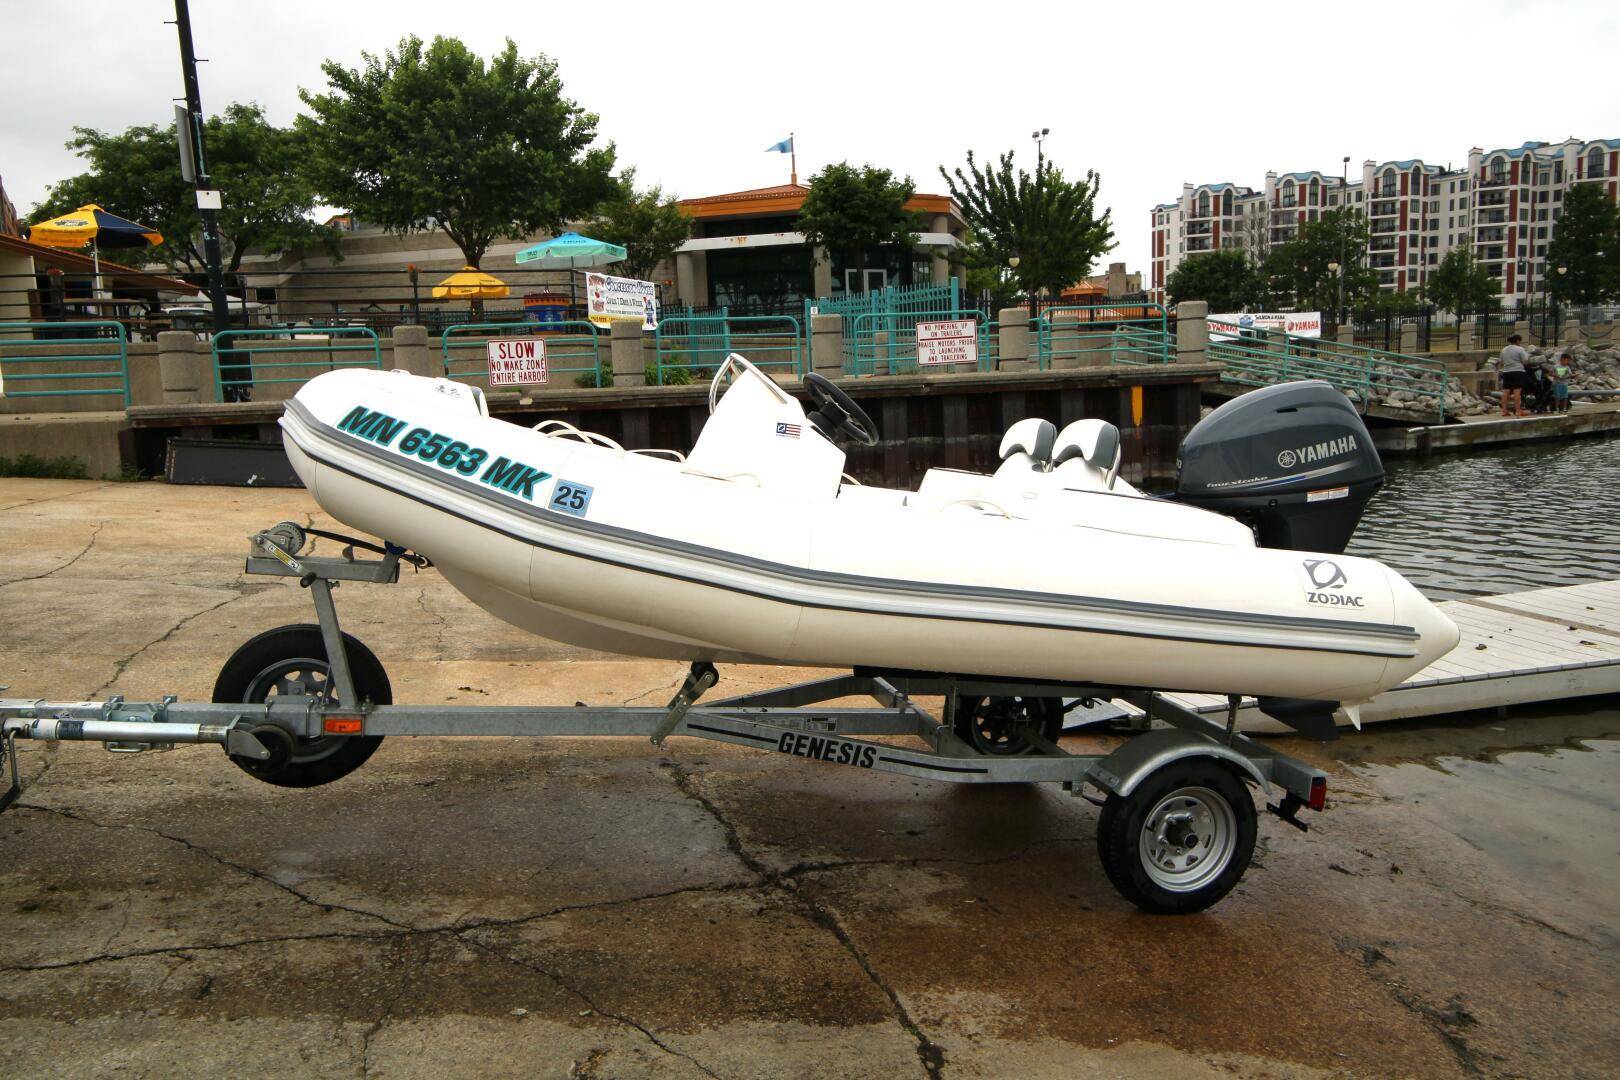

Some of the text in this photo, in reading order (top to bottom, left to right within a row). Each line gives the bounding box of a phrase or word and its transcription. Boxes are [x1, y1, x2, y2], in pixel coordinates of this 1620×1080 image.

[1211, 324, 1239, 332] YAMAHA
[1295, 321, 1319, 331] YAMAHA
[498, 342, 534, 359] SLOW
[938, 346, 966, 354] LAUNCHING
[941, 353, 968, 361] TRAILERING
[491, 359, 545, 371] NO WAKE ZONE
[492, 370, 546, 383] ENTIRE HARBOR
[337, 405, 552, 502] MN 6563 MK
[1296, 434, 1358, 464] YAMAHA
[553, 485, 588, 510] 25
[1307, 591, 1365, 607] ZODIAC
[778, 732, 877, 769] GENESIS
